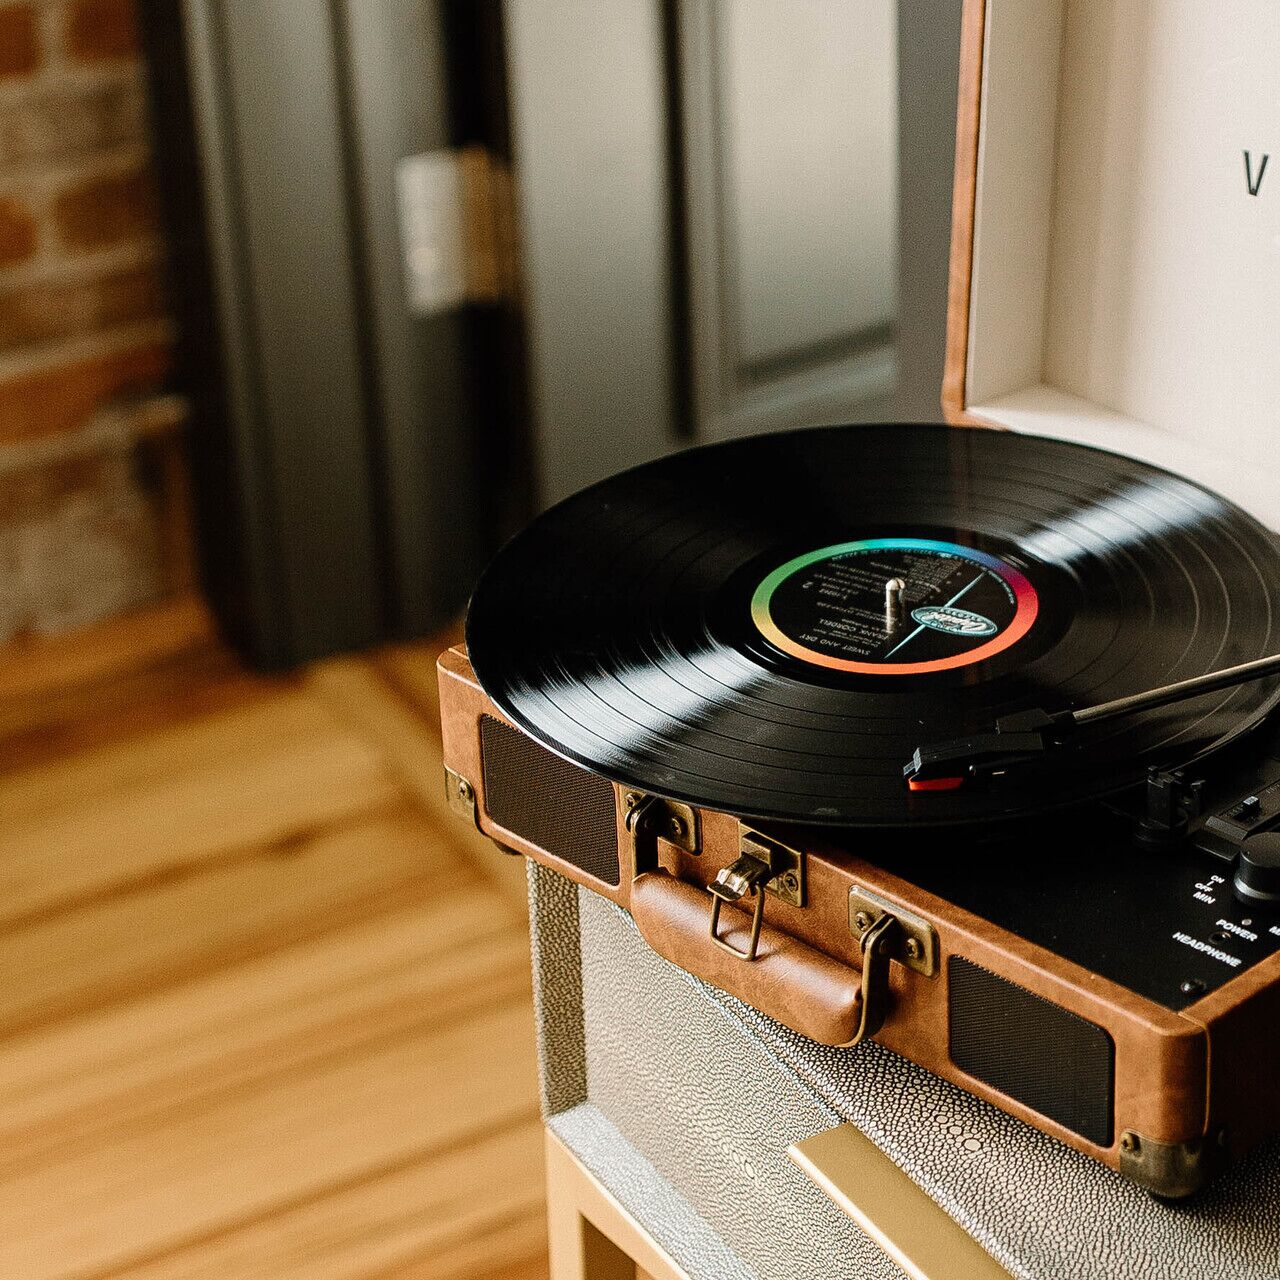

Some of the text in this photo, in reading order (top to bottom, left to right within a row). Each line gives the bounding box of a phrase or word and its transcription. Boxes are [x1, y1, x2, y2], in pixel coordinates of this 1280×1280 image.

[799, 634, 818, 643] DRY
[820, 638, 841, 649] AND
[842, 644, 871, 656] SWEET
[1210, 874, 1225, 884] ON
[1194, 882, 1213, 892] OFF
[1192, 891, 1216, 905] MIN
[1215, 919, 1259, 942] POWER
[1172, 931, 1242, 968] HEADPHONE
